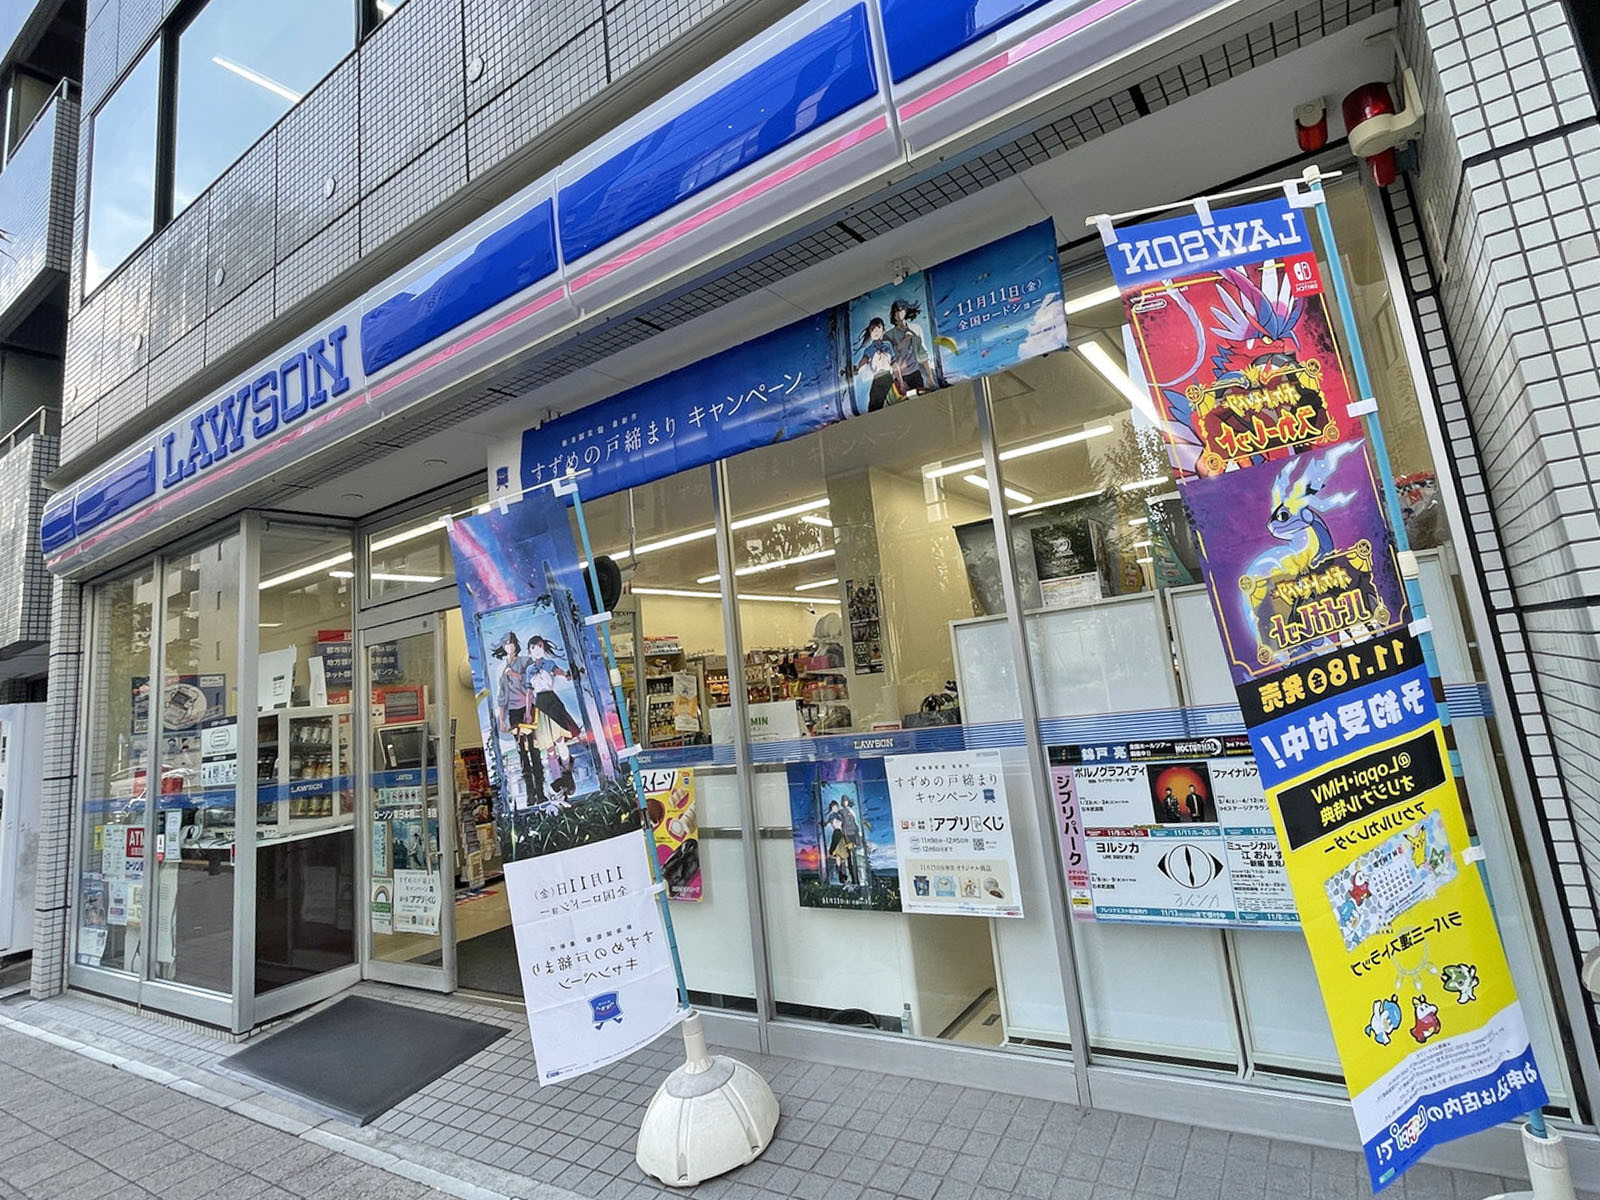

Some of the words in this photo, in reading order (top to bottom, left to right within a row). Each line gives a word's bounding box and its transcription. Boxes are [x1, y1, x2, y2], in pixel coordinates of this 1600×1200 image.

[957, 278, 1042, 318] 11月11日(金)
[957, 299, 1042, 333] 全国ロードショー
[162, 325, 350, 489] LAWSON
[531, 418, 676, 483] すずめの戸締まり
[688, 371, 803, 428] キャンペーン
[853, 738, 894, 749] LAWSON
[1113, 745, 1127, 760] 亮
[1074, 765, 1145, 778] ポルノグラフィティ
[895, 773, 997, 788] すずめの戸締まり
[916, 791, 978, 803] キャンペーン
[934, 816, 970, 831] アプリ
[982, 816, 1004, 831] くじ
[1056, 775, 1082, 866] ジブリパーク
[1095, 842, 1140, 854] ヨルシカ
[1226, 841, 1277, 851] ミュージカル
